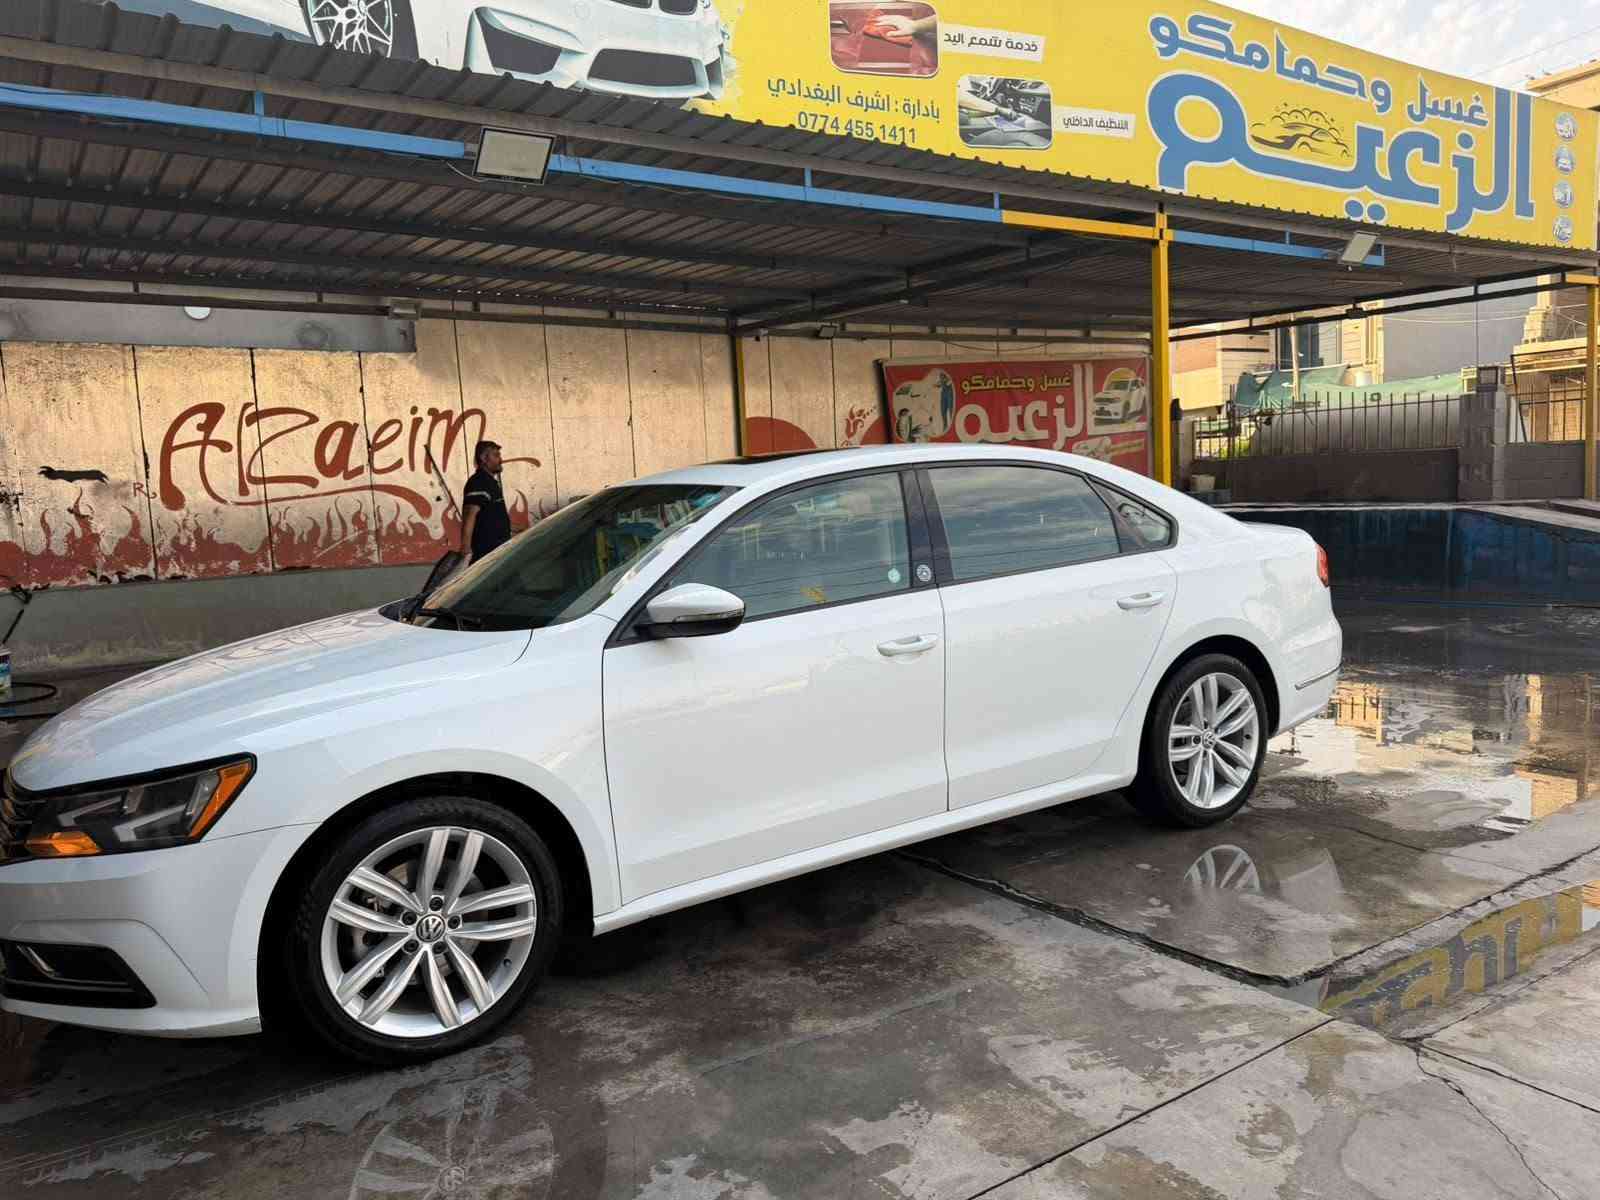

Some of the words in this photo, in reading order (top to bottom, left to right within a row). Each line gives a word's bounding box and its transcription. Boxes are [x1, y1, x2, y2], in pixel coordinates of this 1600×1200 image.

[943, 32, 965, 46] اليد
[967, 35, 1002, 49] شمع
[1004, 37, 1038, 52] خدمة
[767, 78, 841, 106] البغدادي
[846, 90, 891, 113] اشرف
[1407, 73, 1489, 127] غسل
[798, 111, 841, 133] 0774
[844, 118, 875, 138] 455
[879, 124, 916, 143] 1411
[1063, 116, 1094, 129] الداخلي
[1147, 73, 1535, 231] الزعيم
[1040, 372, 1072, 391] غسل
